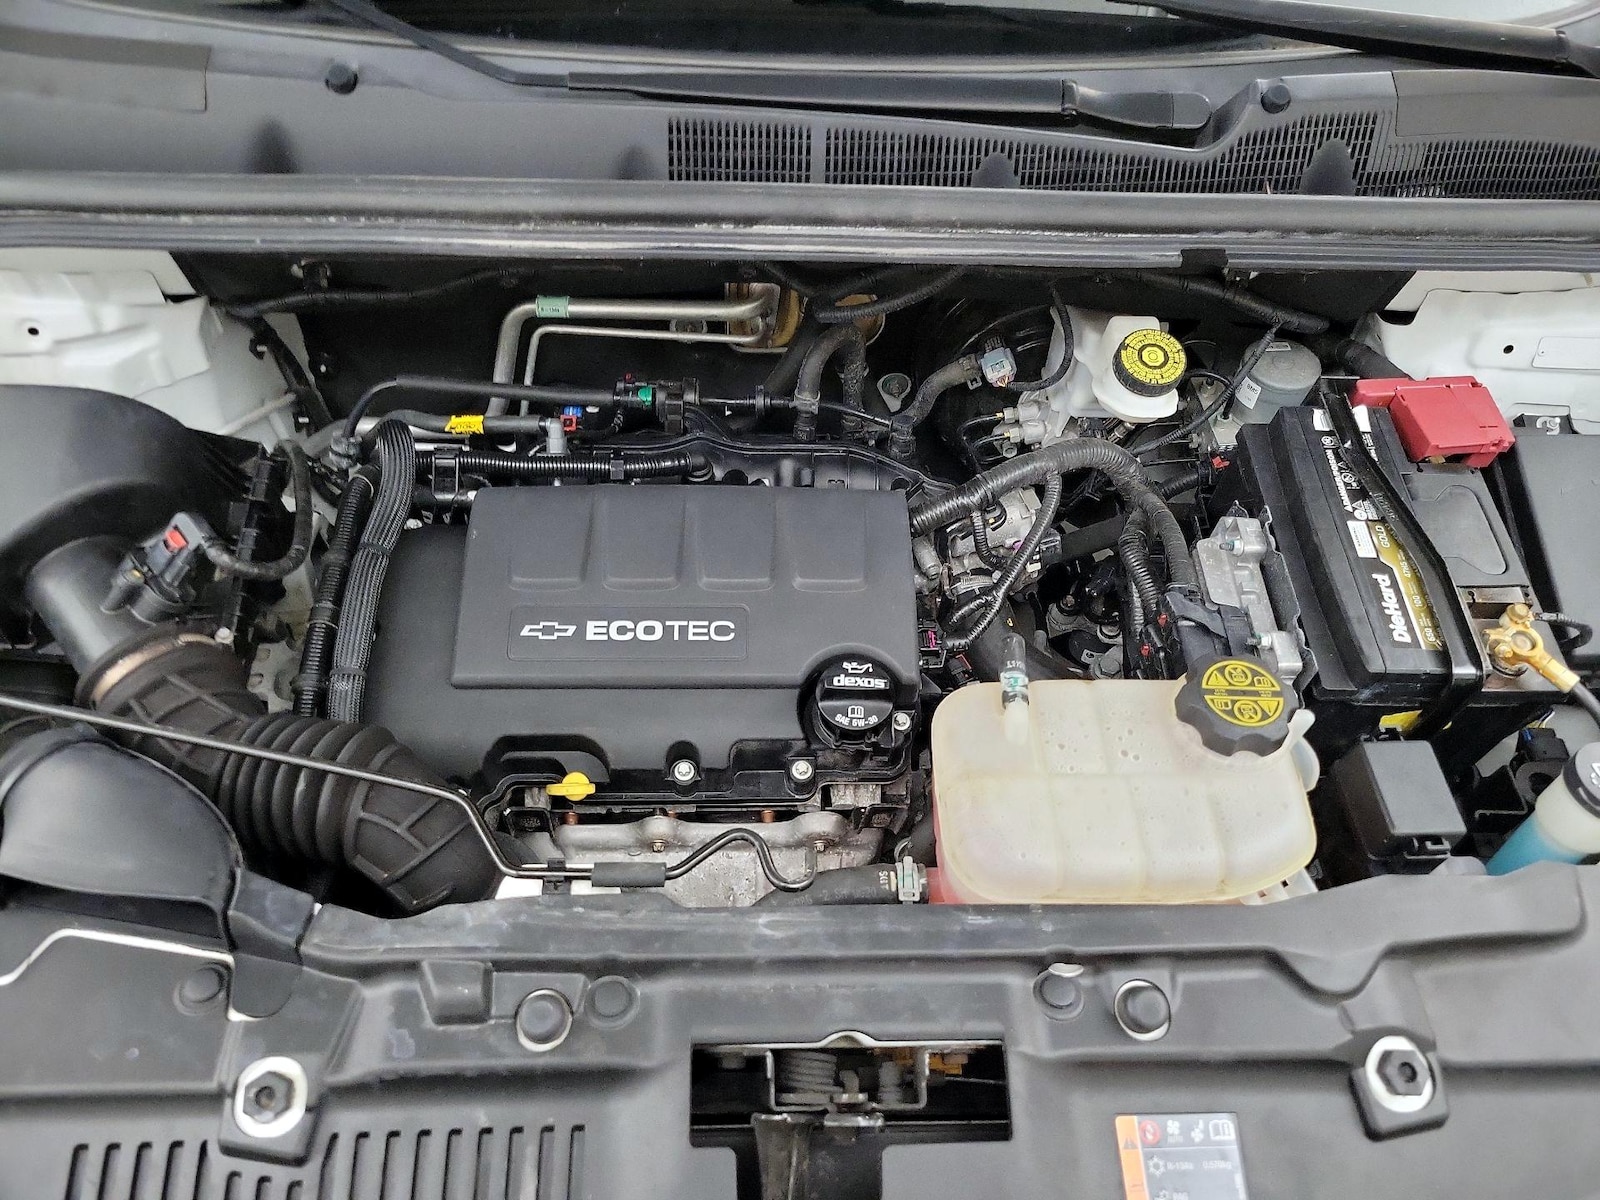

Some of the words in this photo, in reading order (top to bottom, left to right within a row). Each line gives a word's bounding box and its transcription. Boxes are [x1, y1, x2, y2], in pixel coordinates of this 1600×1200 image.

[1375, 525, 1391, 548] GOLD
[1373, 573, 1412, 643] DieHard
[585, 620, 736, 641] ECOTEC
[833, 674, 887, 689] dexos
[835, 713, 850, 726] SAE
